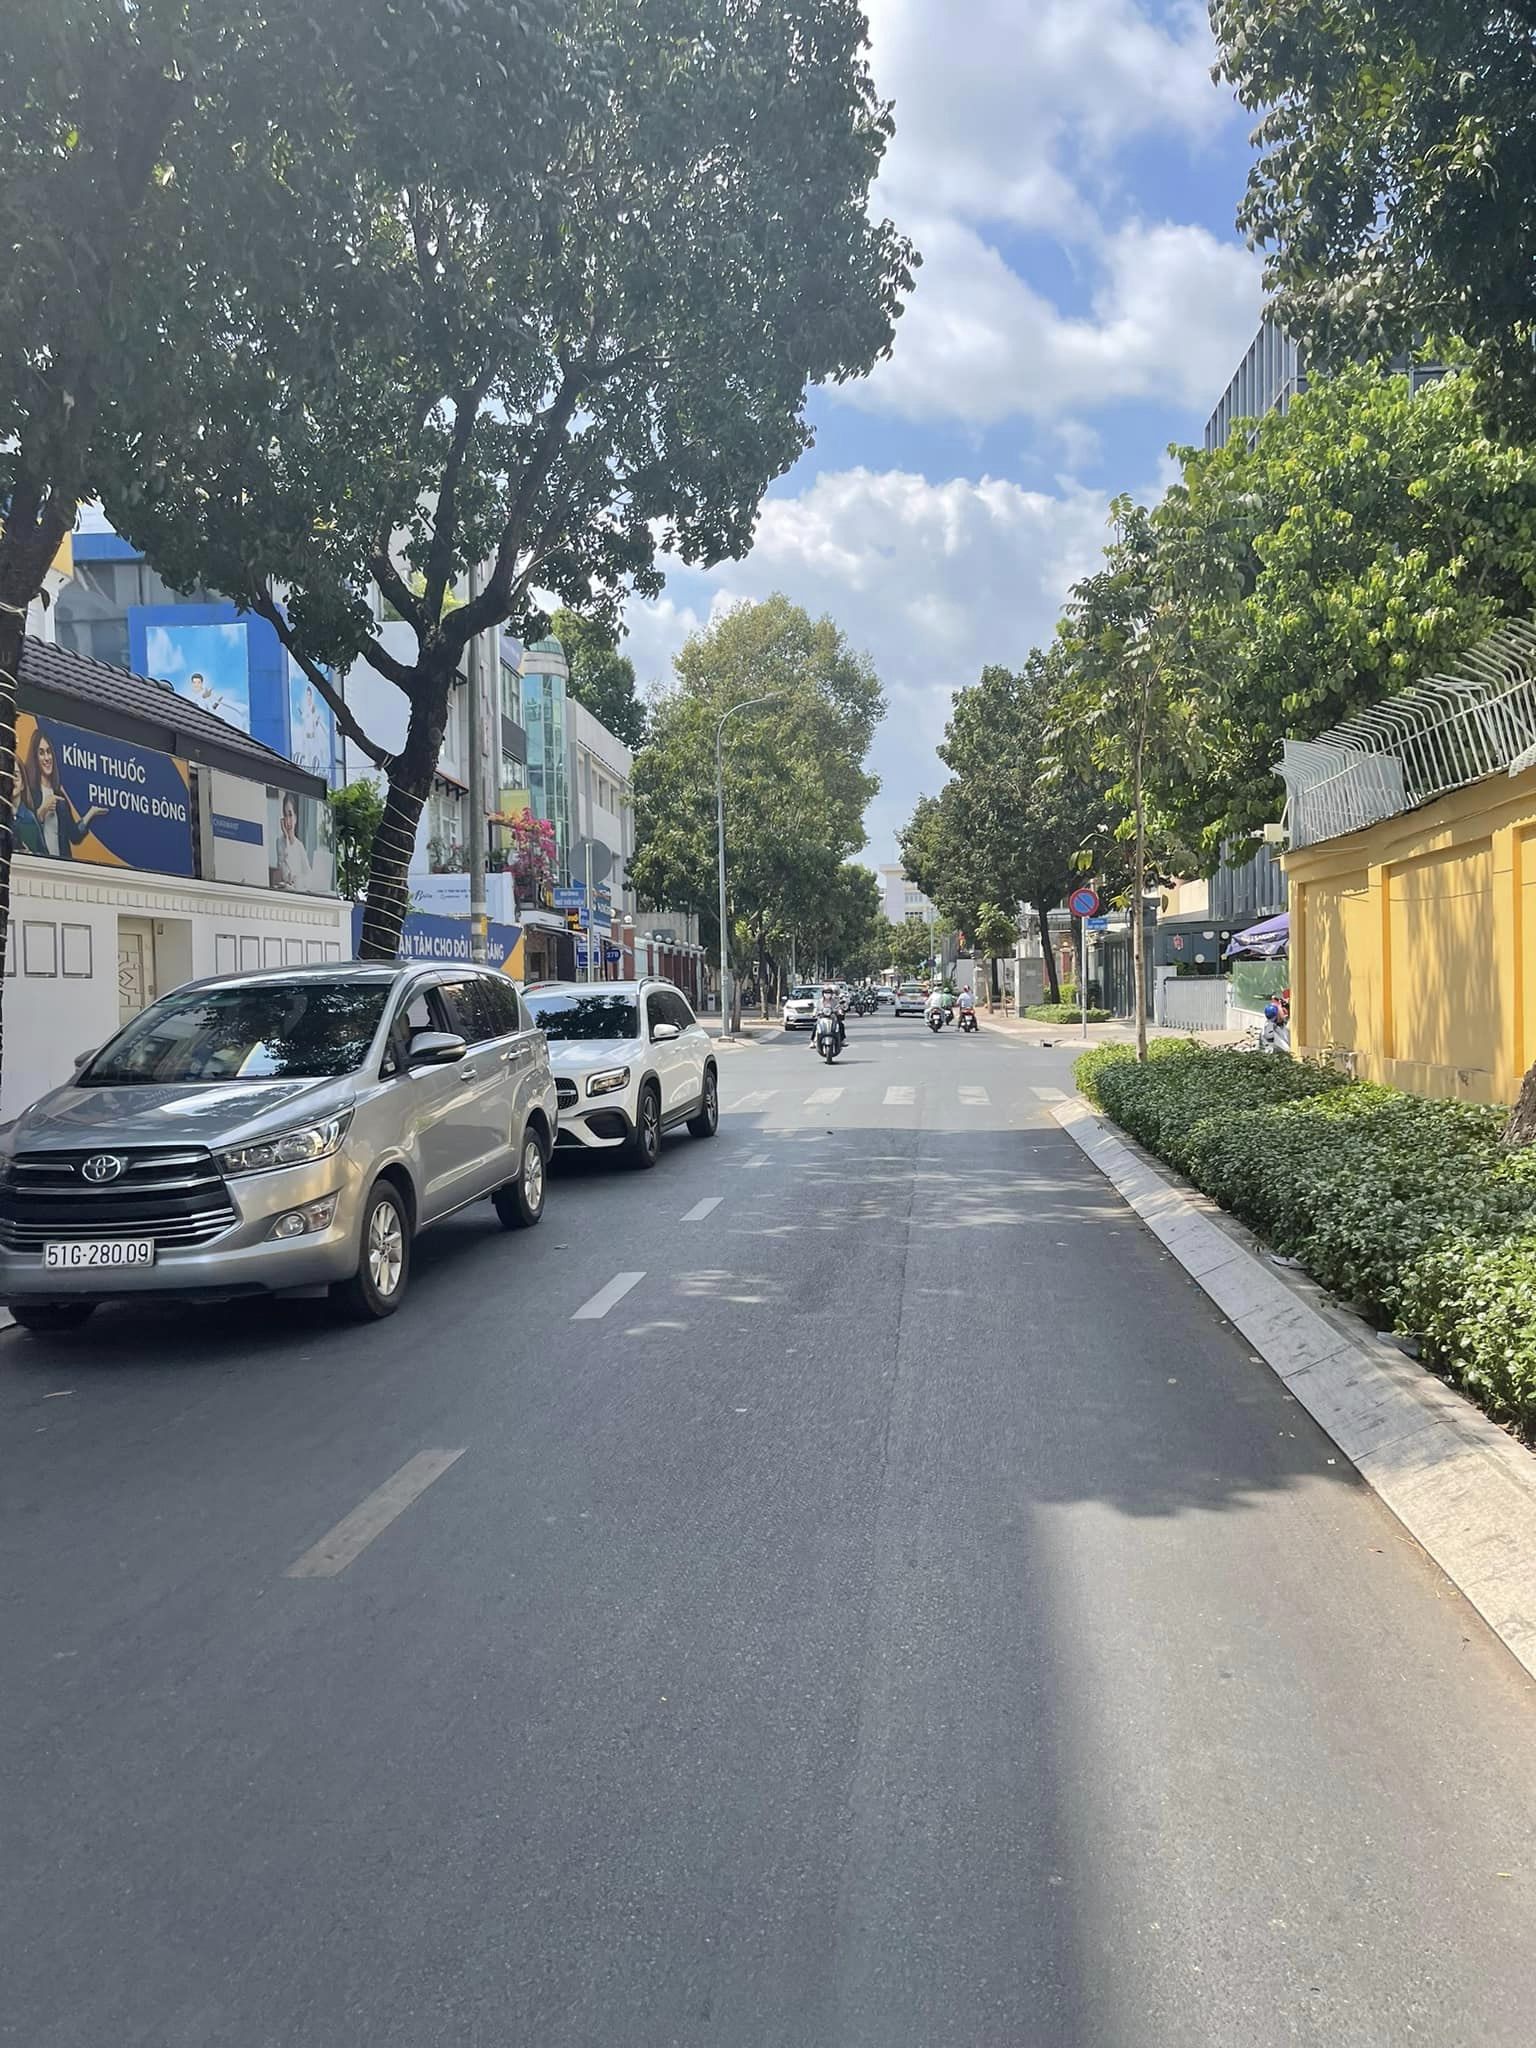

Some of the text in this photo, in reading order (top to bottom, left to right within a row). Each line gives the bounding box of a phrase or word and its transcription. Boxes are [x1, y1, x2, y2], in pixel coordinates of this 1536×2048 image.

[62, 743, 146, 783] KÍNH THUỐC
[89, 783, 186, 821] PHƯƠNG ĐÔNG
[414, 930, 433, 956] TÂM
[434, 936, 453, 957] CHO
[48, 1243, 148, 1265] 51G-280.09
